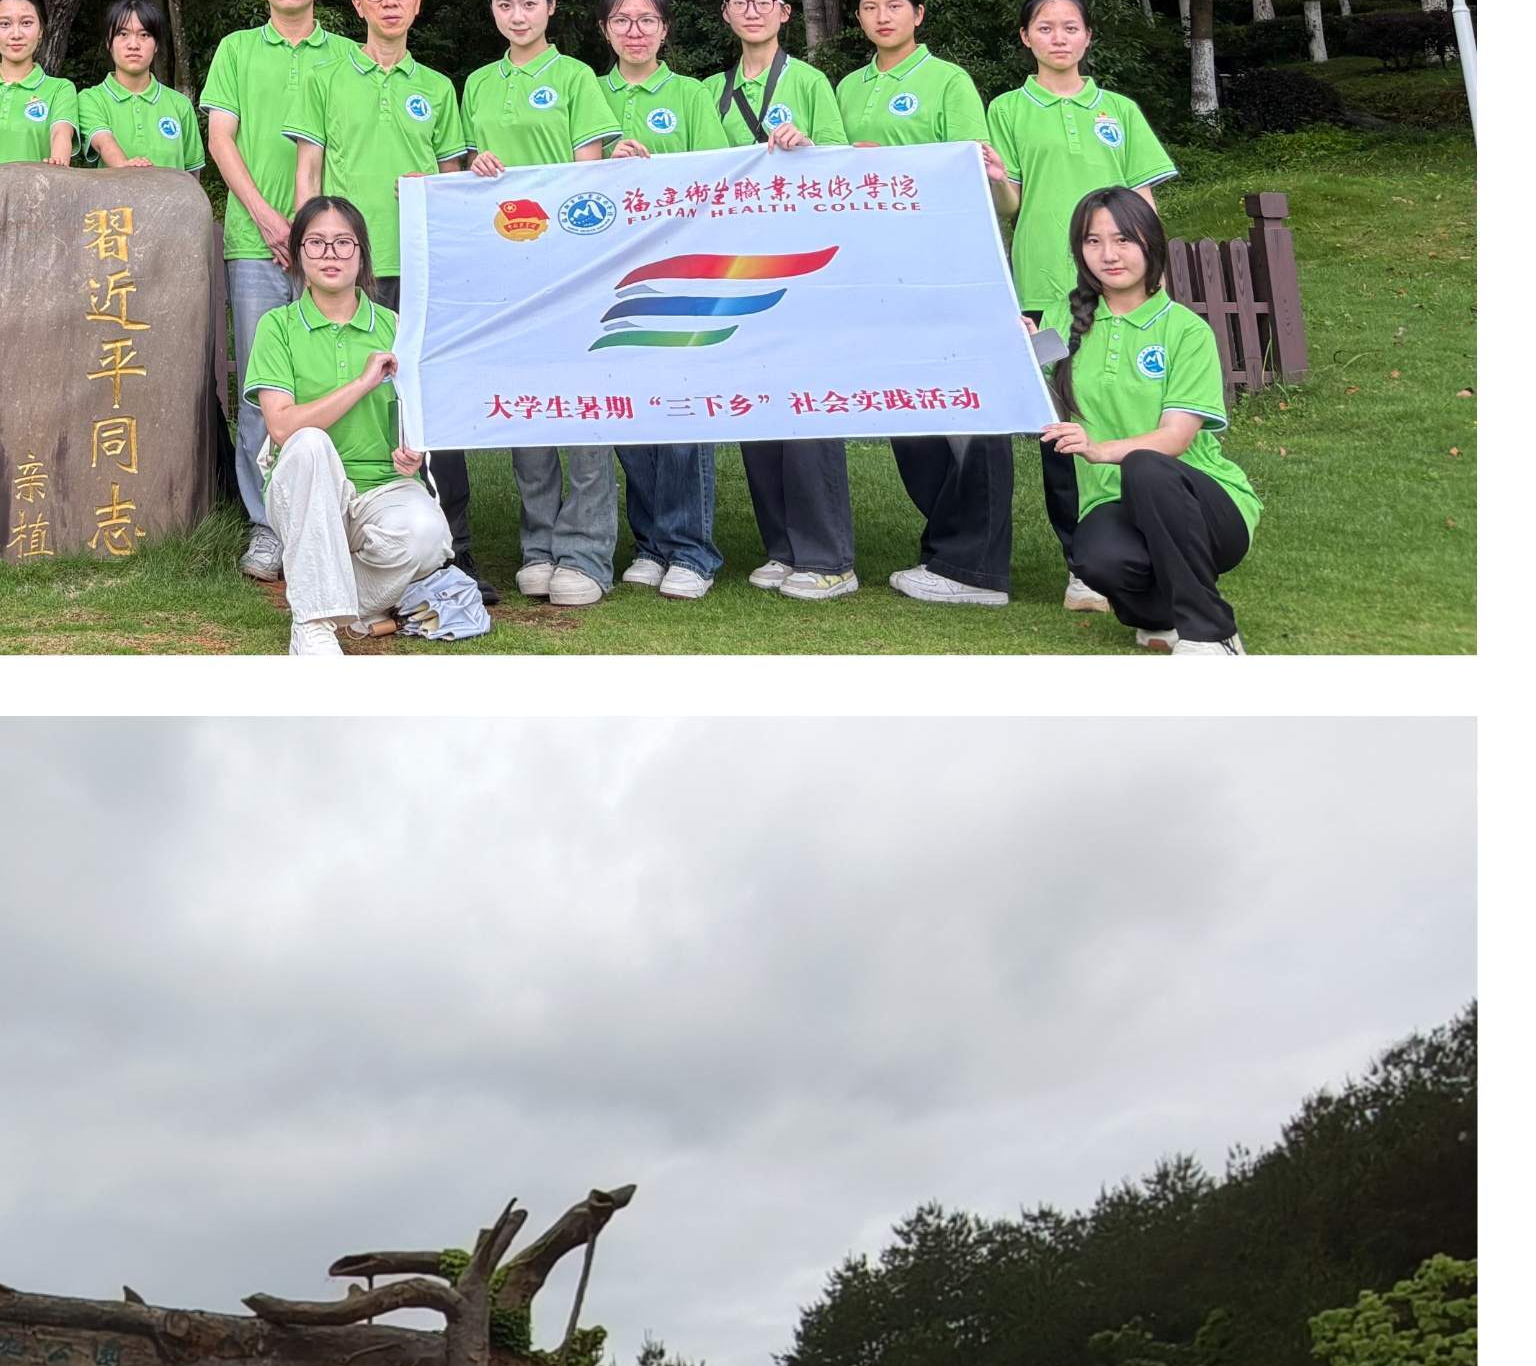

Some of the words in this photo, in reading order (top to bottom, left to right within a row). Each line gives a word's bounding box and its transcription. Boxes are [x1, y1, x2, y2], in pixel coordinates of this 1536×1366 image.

[627, 208, 698, 226] FUJIAN
[710, 203, 797, 218] HEALTH
[813, 201, 922, 212] COLLEGE
